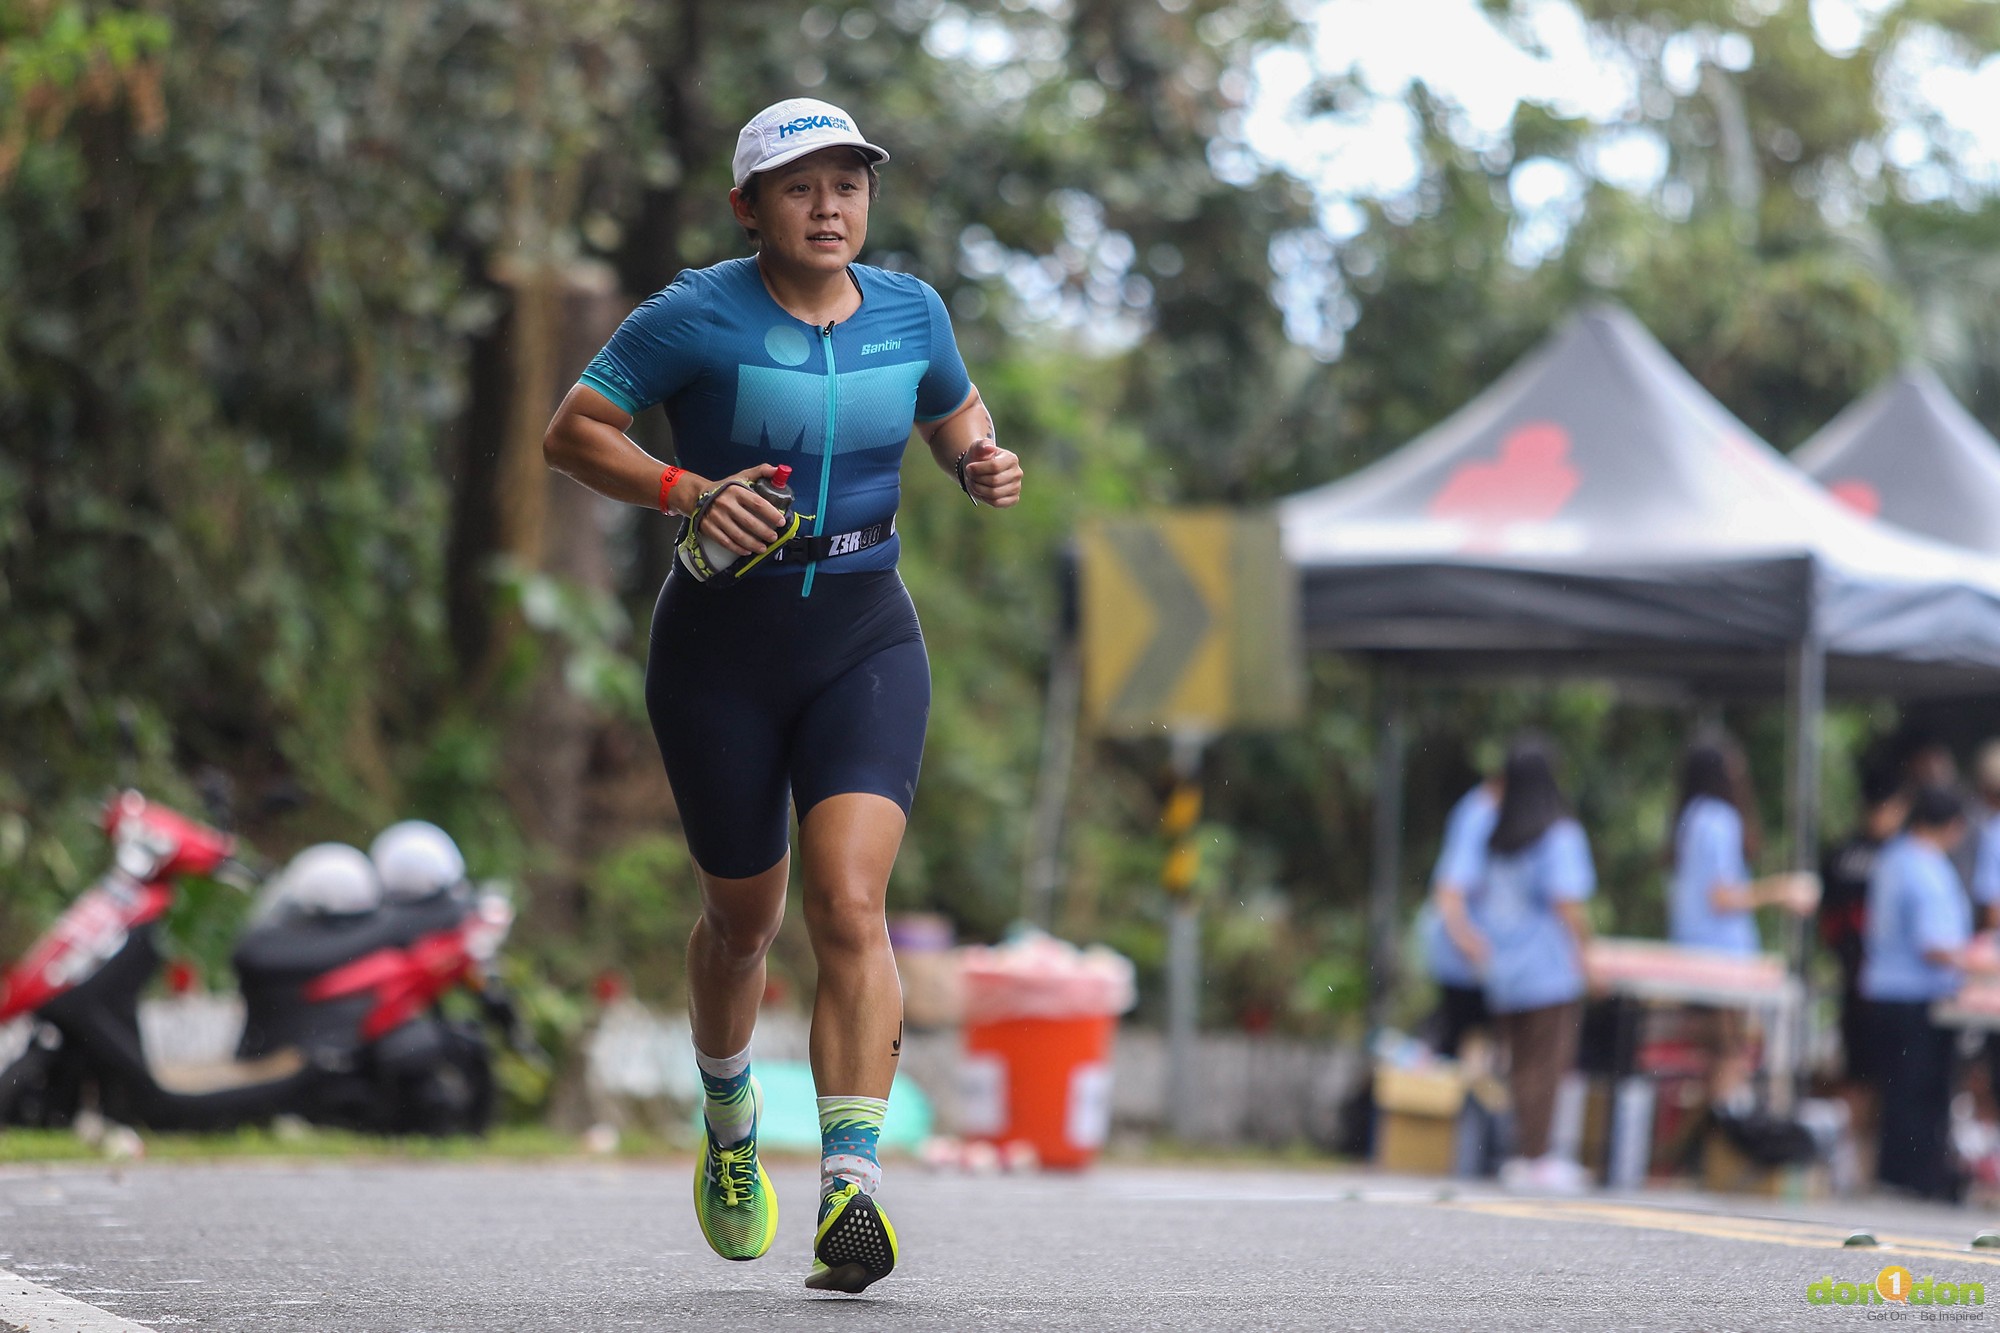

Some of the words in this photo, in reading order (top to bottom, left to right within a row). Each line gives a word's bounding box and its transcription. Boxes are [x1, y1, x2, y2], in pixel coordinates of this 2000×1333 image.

[779, 115, 832, 138] HOKA
[829, 116, 847, 125] ONE
[832, 122, 851, 132] ONE
[861, 338, 901, 355] Santini
